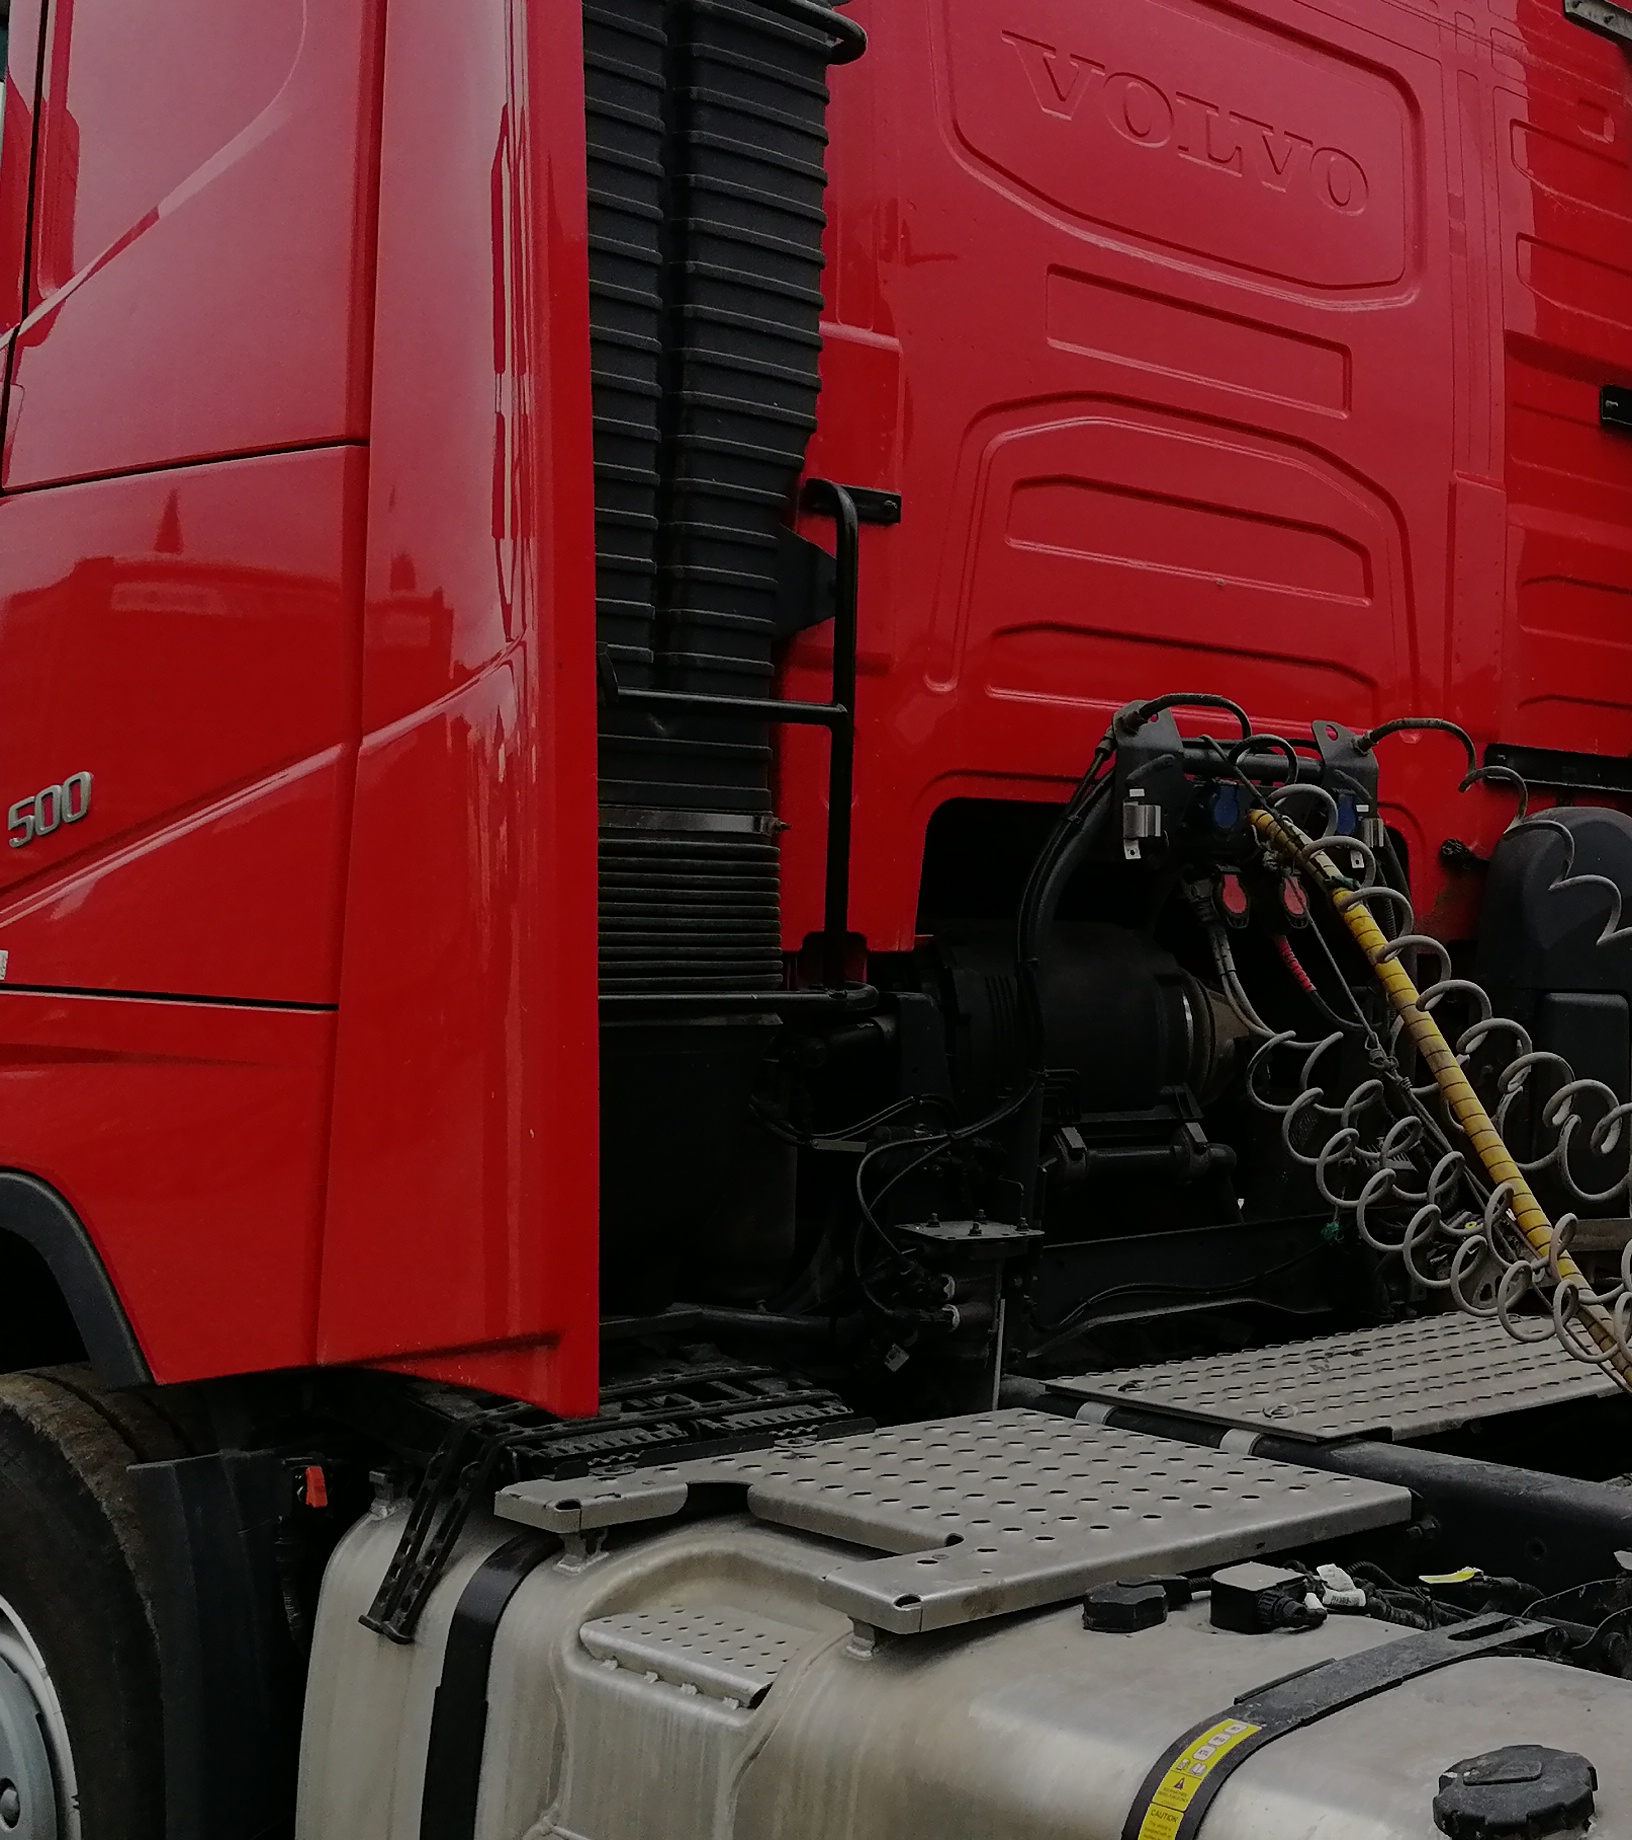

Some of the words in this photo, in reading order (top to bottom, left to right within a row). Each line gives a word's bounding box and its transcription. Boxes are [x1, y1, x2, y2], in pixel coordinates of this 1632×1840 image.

[1001, 29, 1369, 217] VOLVO
[8, 771, 92, 848] 500
[1150, 1809, 1179, 1823] CAUTION
